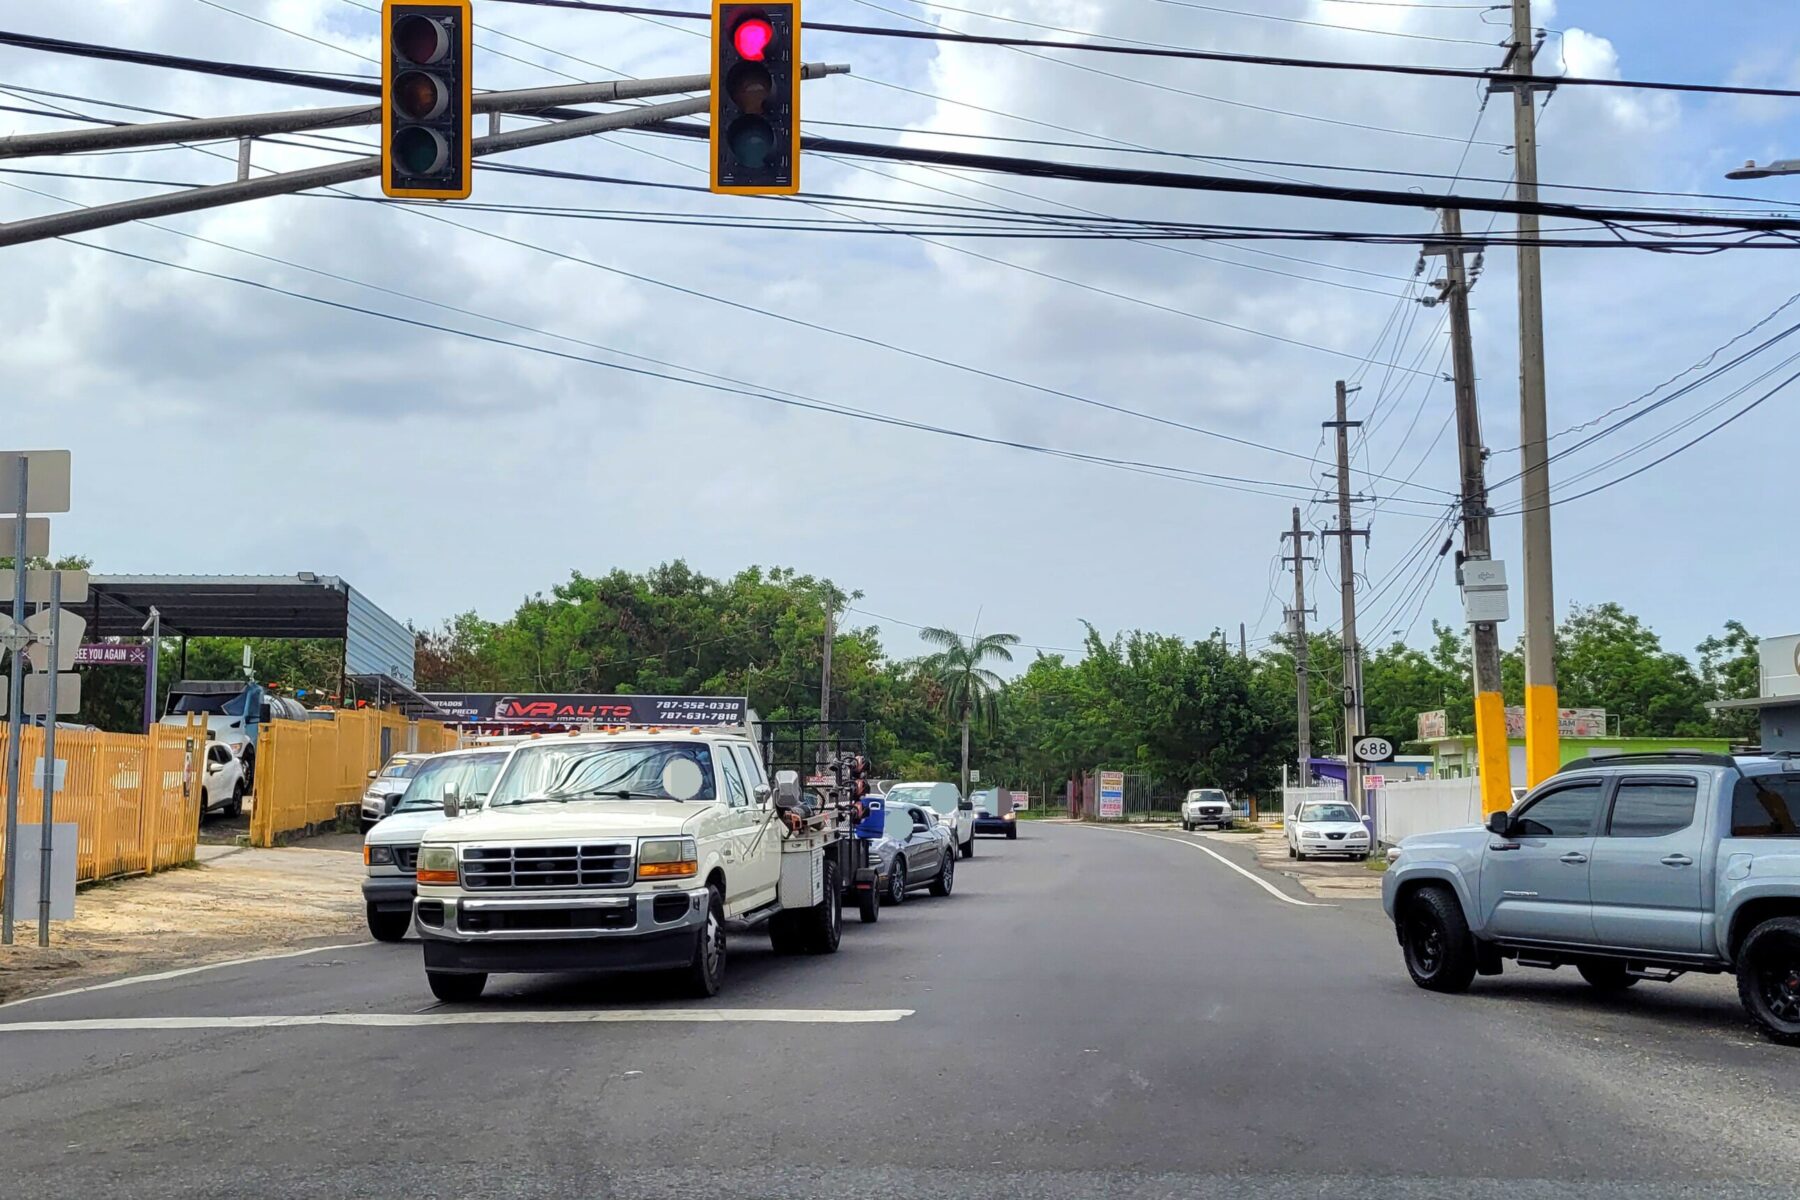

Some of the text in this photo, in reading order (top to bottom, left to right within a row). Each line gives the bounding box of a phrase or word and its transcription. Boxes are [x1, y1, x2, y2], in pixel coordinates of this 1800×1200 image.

[75, 648, 127, 661] SEE YOU AGAIN
[556, 705, 632, 717] AUTO
[656, 701, 740, 711] 787-552-0330
[1359, 742, 1388, 756] 688
